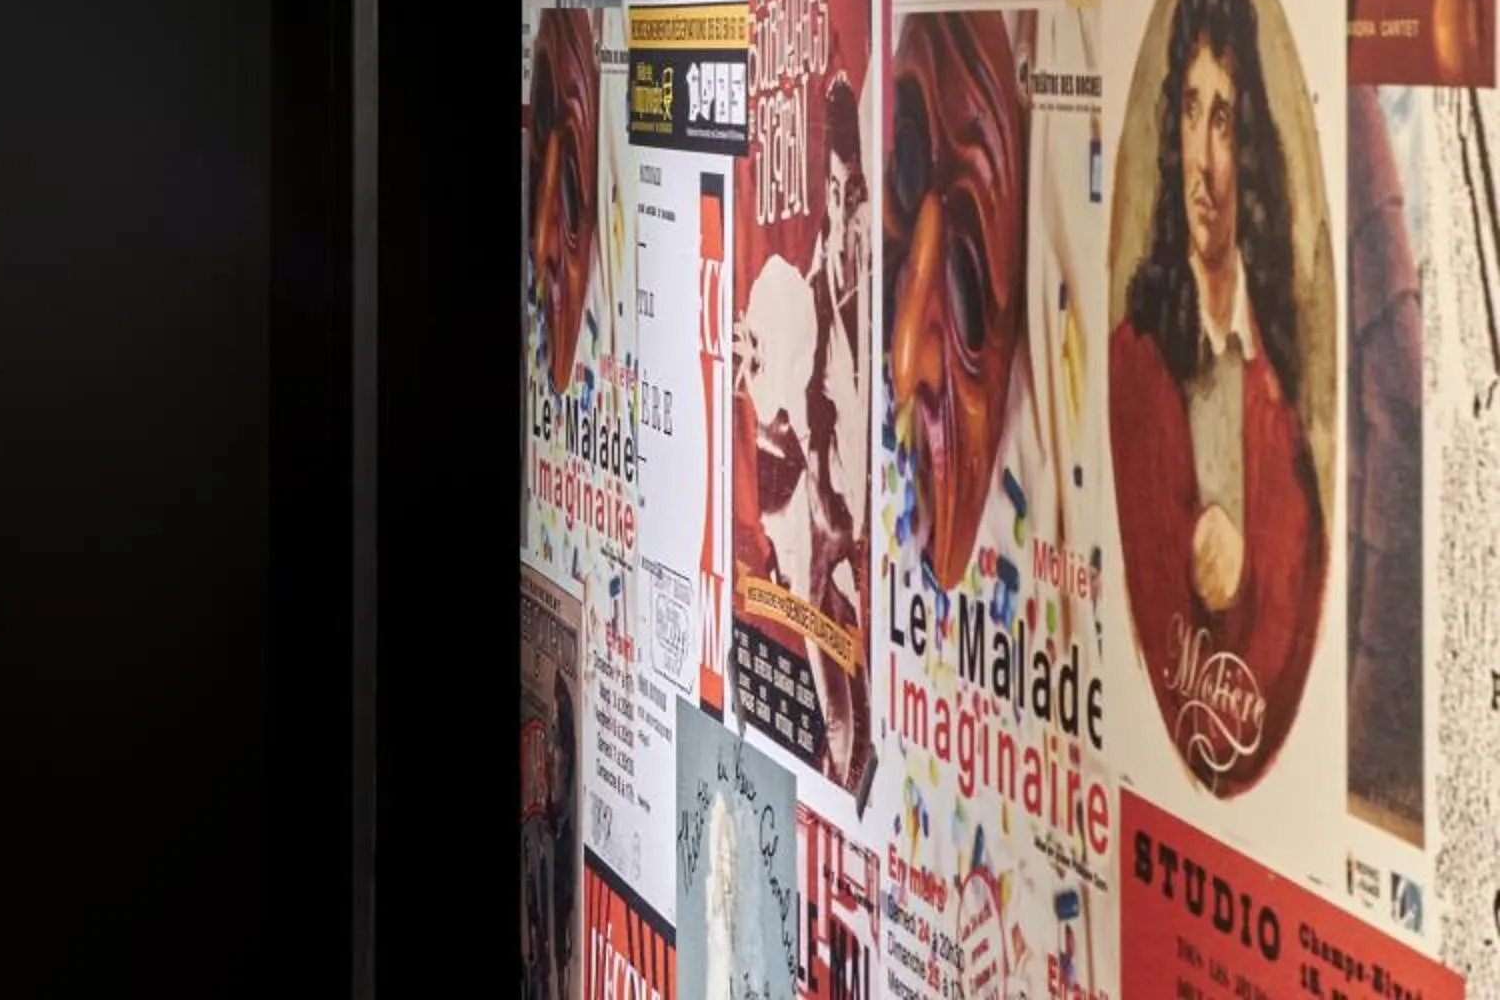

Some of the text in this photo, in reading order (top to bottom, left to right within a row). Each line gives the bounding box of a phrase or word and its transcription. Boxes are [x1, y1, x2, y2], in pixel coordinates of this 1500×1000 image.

[532, 380, 634, 479] Le Malade
[532, 452, 634, 552] Imaginaire
[888, 561, 927, 652] Le
[958, 593, 1104, 750] Malade
[889, 651, 1108, 855] Imaginaire
[887, 840, 906, 890] En
[1134, 829, 1281, 961] STUDIO
[888, 930, 925, 980] Dimanche
